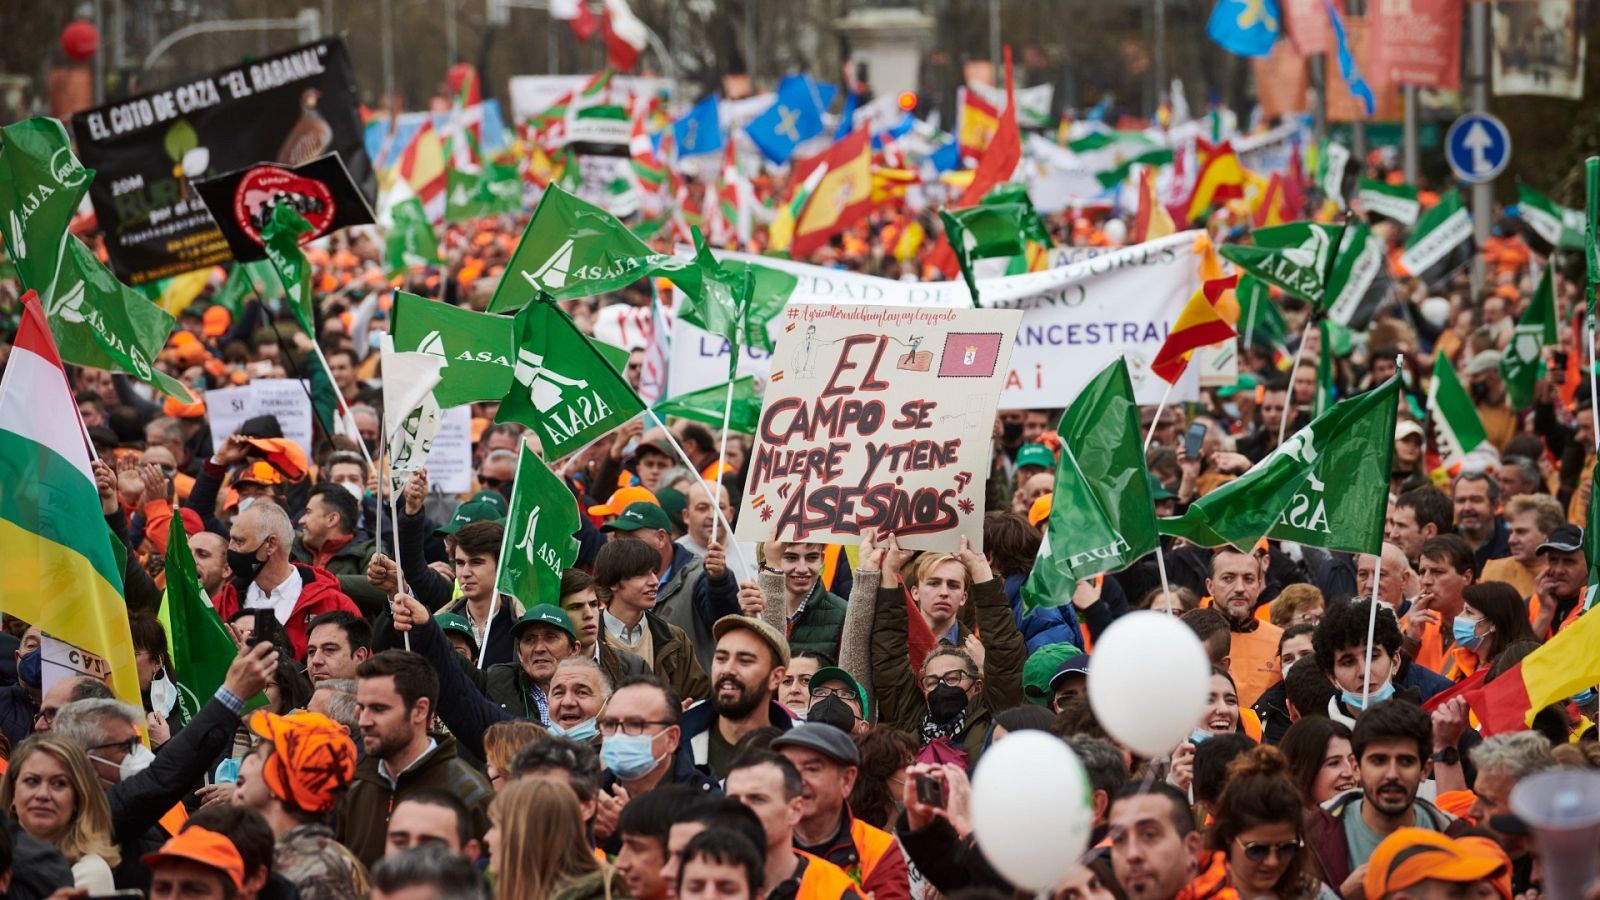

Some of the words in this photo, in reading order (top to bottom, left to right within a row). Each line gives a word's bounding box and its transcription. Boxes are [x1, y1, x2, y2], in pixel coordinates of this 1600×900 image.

[88, 112, 111, 141] EL
[109, 101, 152, 135] COTO
[152, 91, 179, 126] DE
[176, 78, 221, 114] CAZA
[572, 256, 640, 280] ASAJA
[456, 349, 515, 369] ASA
[820, 333, 889, 398] EL
[760, 396, 886, 447] CAMPO
[892, 399, 937, 430] SE
[749, 441, 851, 495] MUERE
[536, 542, 563, 580] ASA
